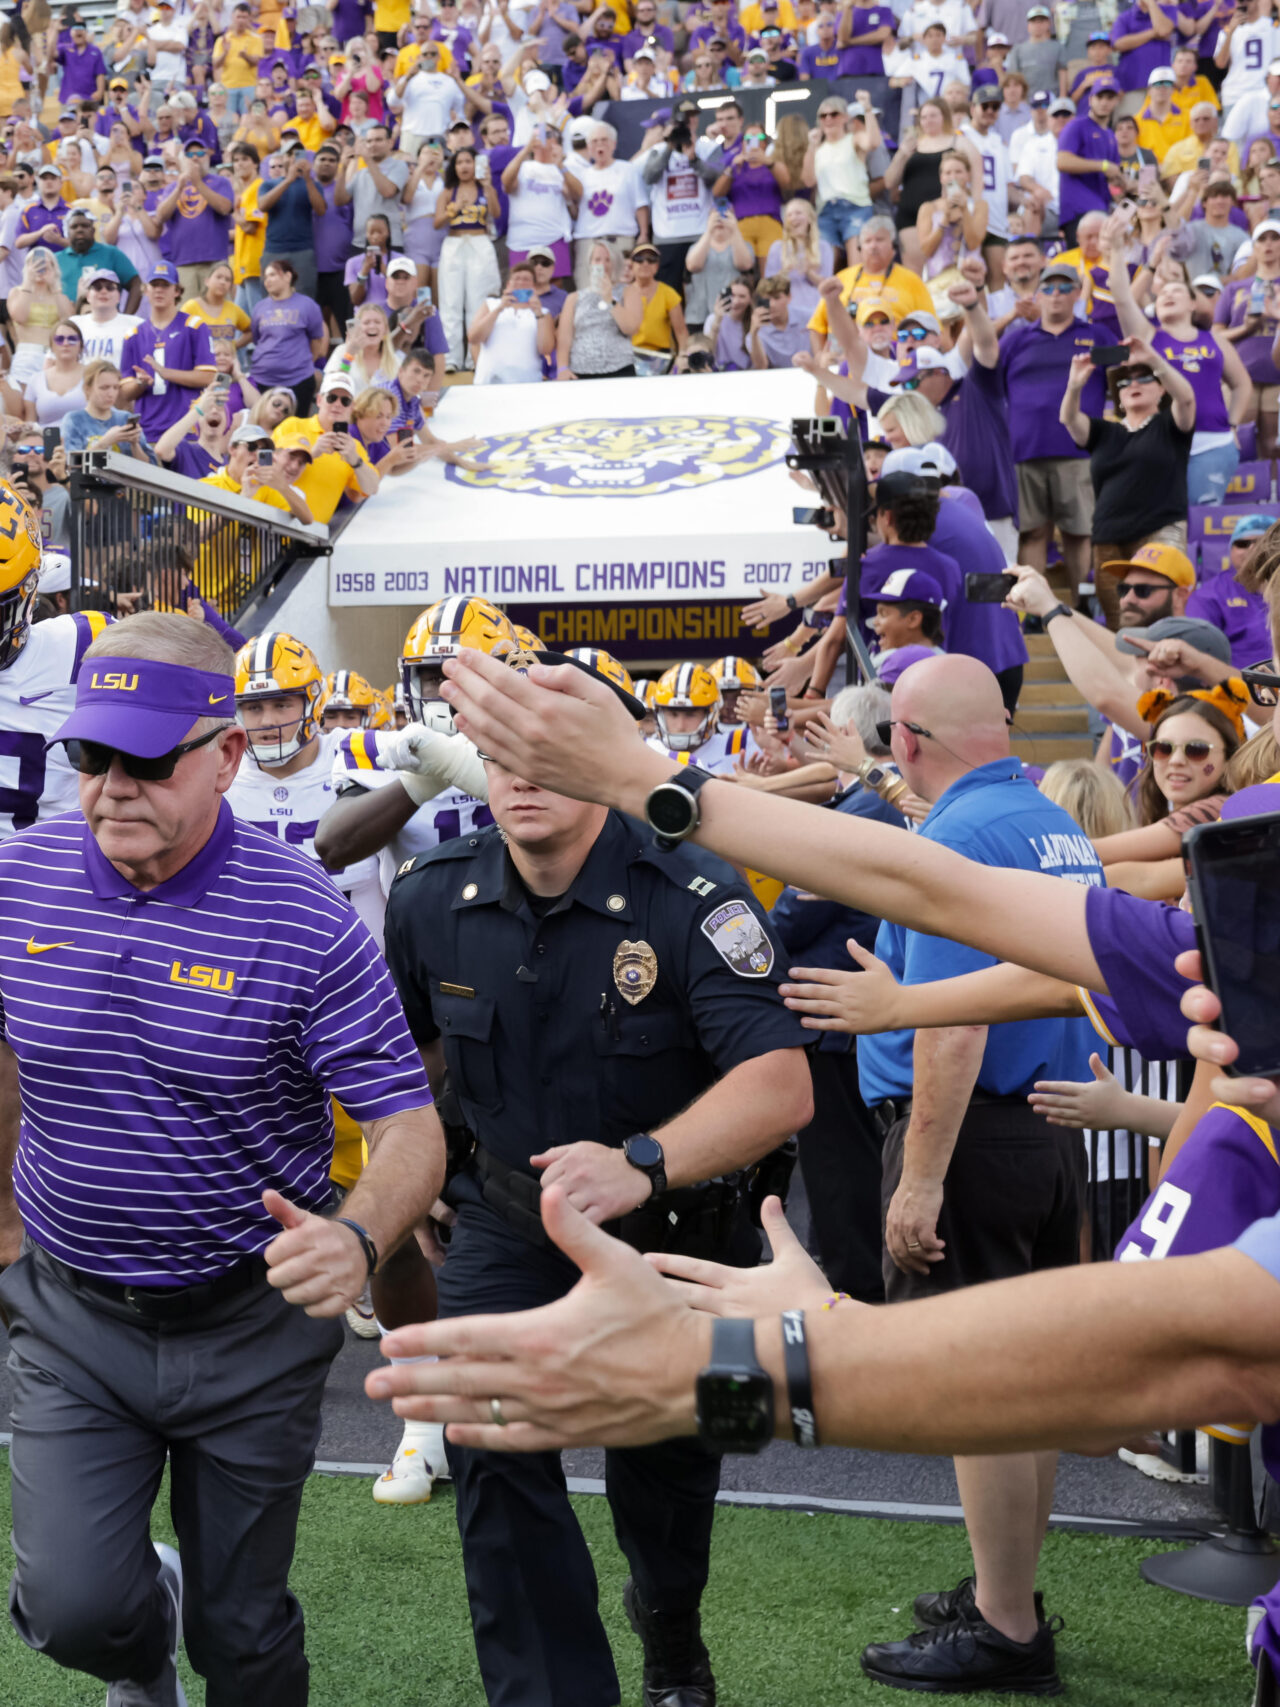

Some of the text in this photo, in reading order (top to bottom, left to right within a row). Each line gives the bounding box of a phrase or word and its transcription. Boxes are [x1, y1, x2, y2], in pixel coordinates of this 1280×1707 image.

[1245, 38, 1263, 69] 9
[928, 71, 944, 98] 7
[666, 203, 700, 213] MEDIA
[336, 573, 375, 593] 1958
[384, 571, 428, 592] 2003
[444, 565, 564, 594] NATIONAL
[575, 561, 725, 591] CHAMPIONS
[744, 562, 791, 584] 2007
[432, 646, 453, 655] LSU
[90, 673, 139, 691] LSU
[250, 682, 269, 691] LSU
[269, 808, 293, 817] LSU
[709, 904, 745, 931] POLICE
[170, 961, 235, 991] LSU
[1120, 1181, 1192, 1262] 9
